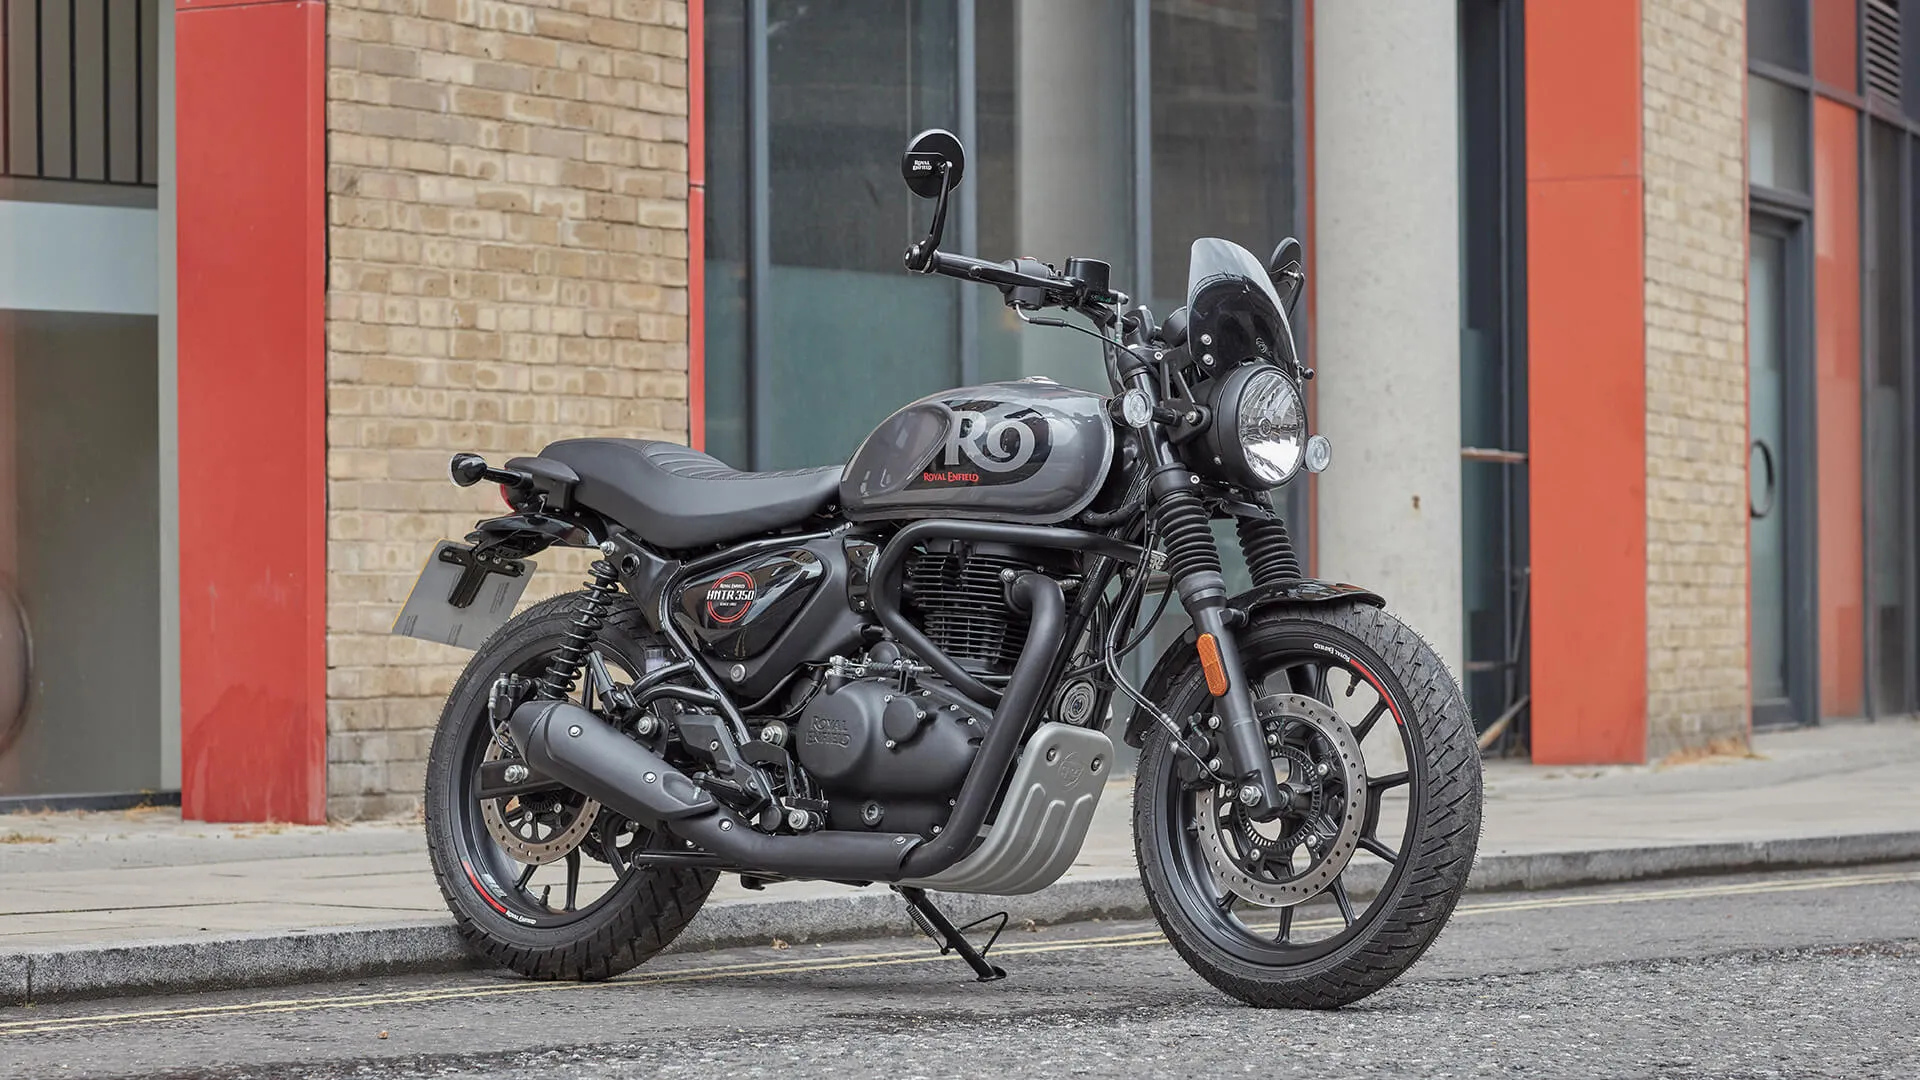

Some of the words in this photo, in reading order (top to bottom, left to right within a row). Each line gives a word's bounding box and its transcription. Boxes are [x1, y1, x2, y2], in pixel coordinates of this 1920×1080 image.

[923, 472, 946, 482] ROYAL
[947, 472, 979, 482] ENFIELD
[706, 590, 735, 600] HNTR
[735, 590, 755, 600] 350
[811, 715, 849, 732] ROYAL
[805, 730, 852, 749] ENFIELD
